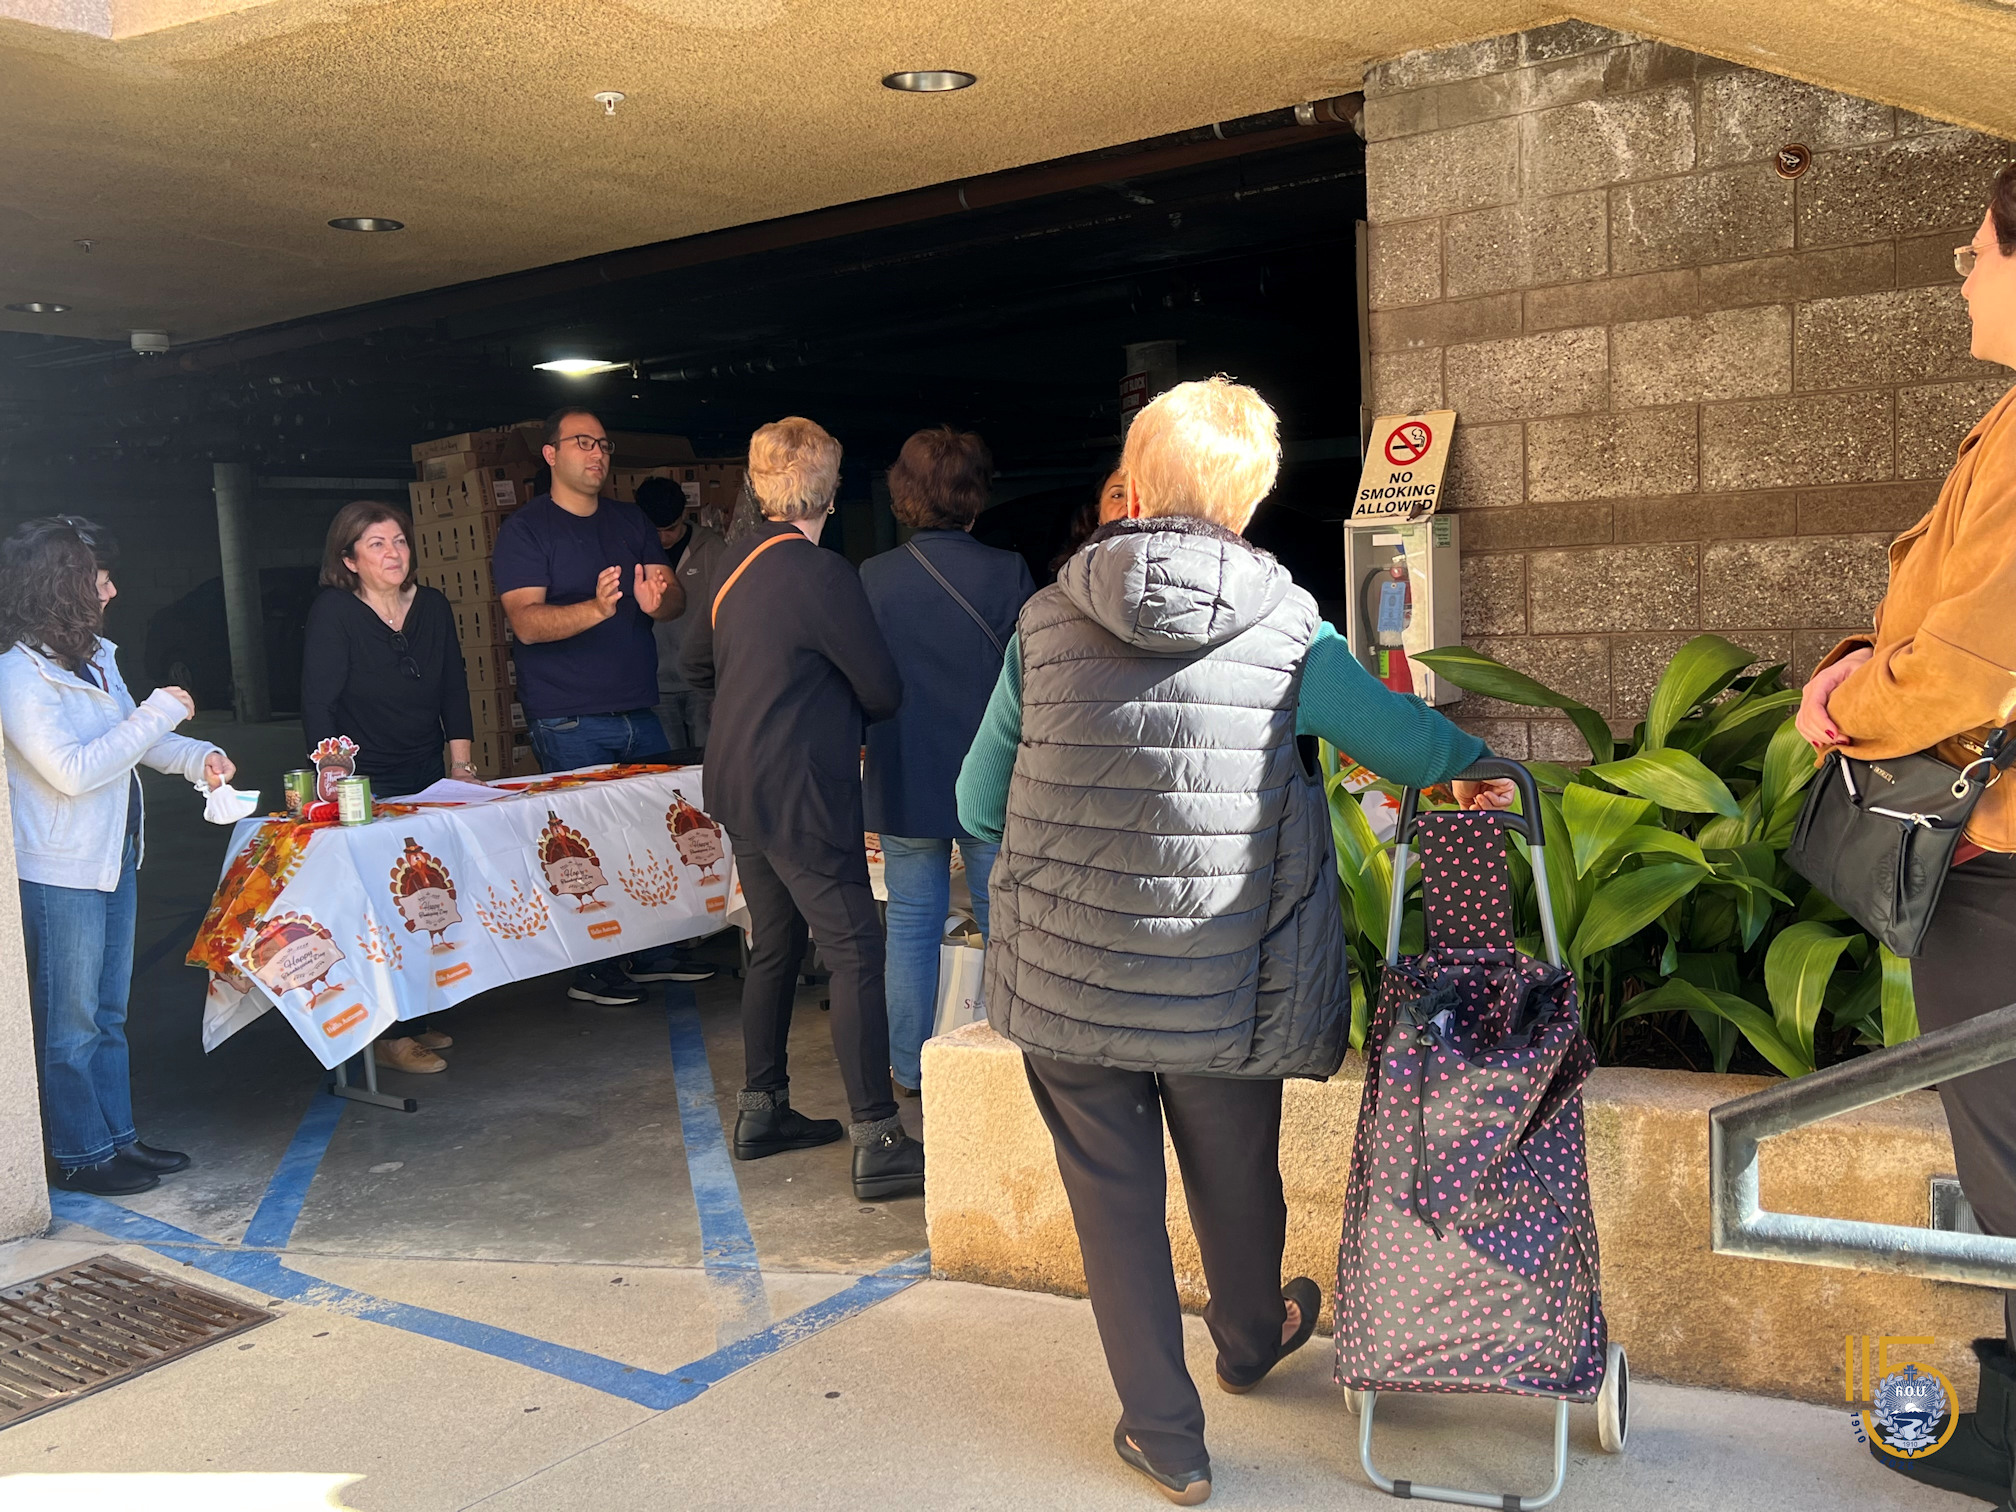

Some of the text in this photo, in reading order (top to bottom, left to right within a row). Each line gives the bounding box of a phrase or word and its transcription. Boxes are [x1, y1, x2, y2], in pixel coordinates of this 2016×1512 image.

[1389, 472, 1413, 484] NO
[1360, 484, 1436, 500] SMOKING
[283, 950, 313, 969] Happy
